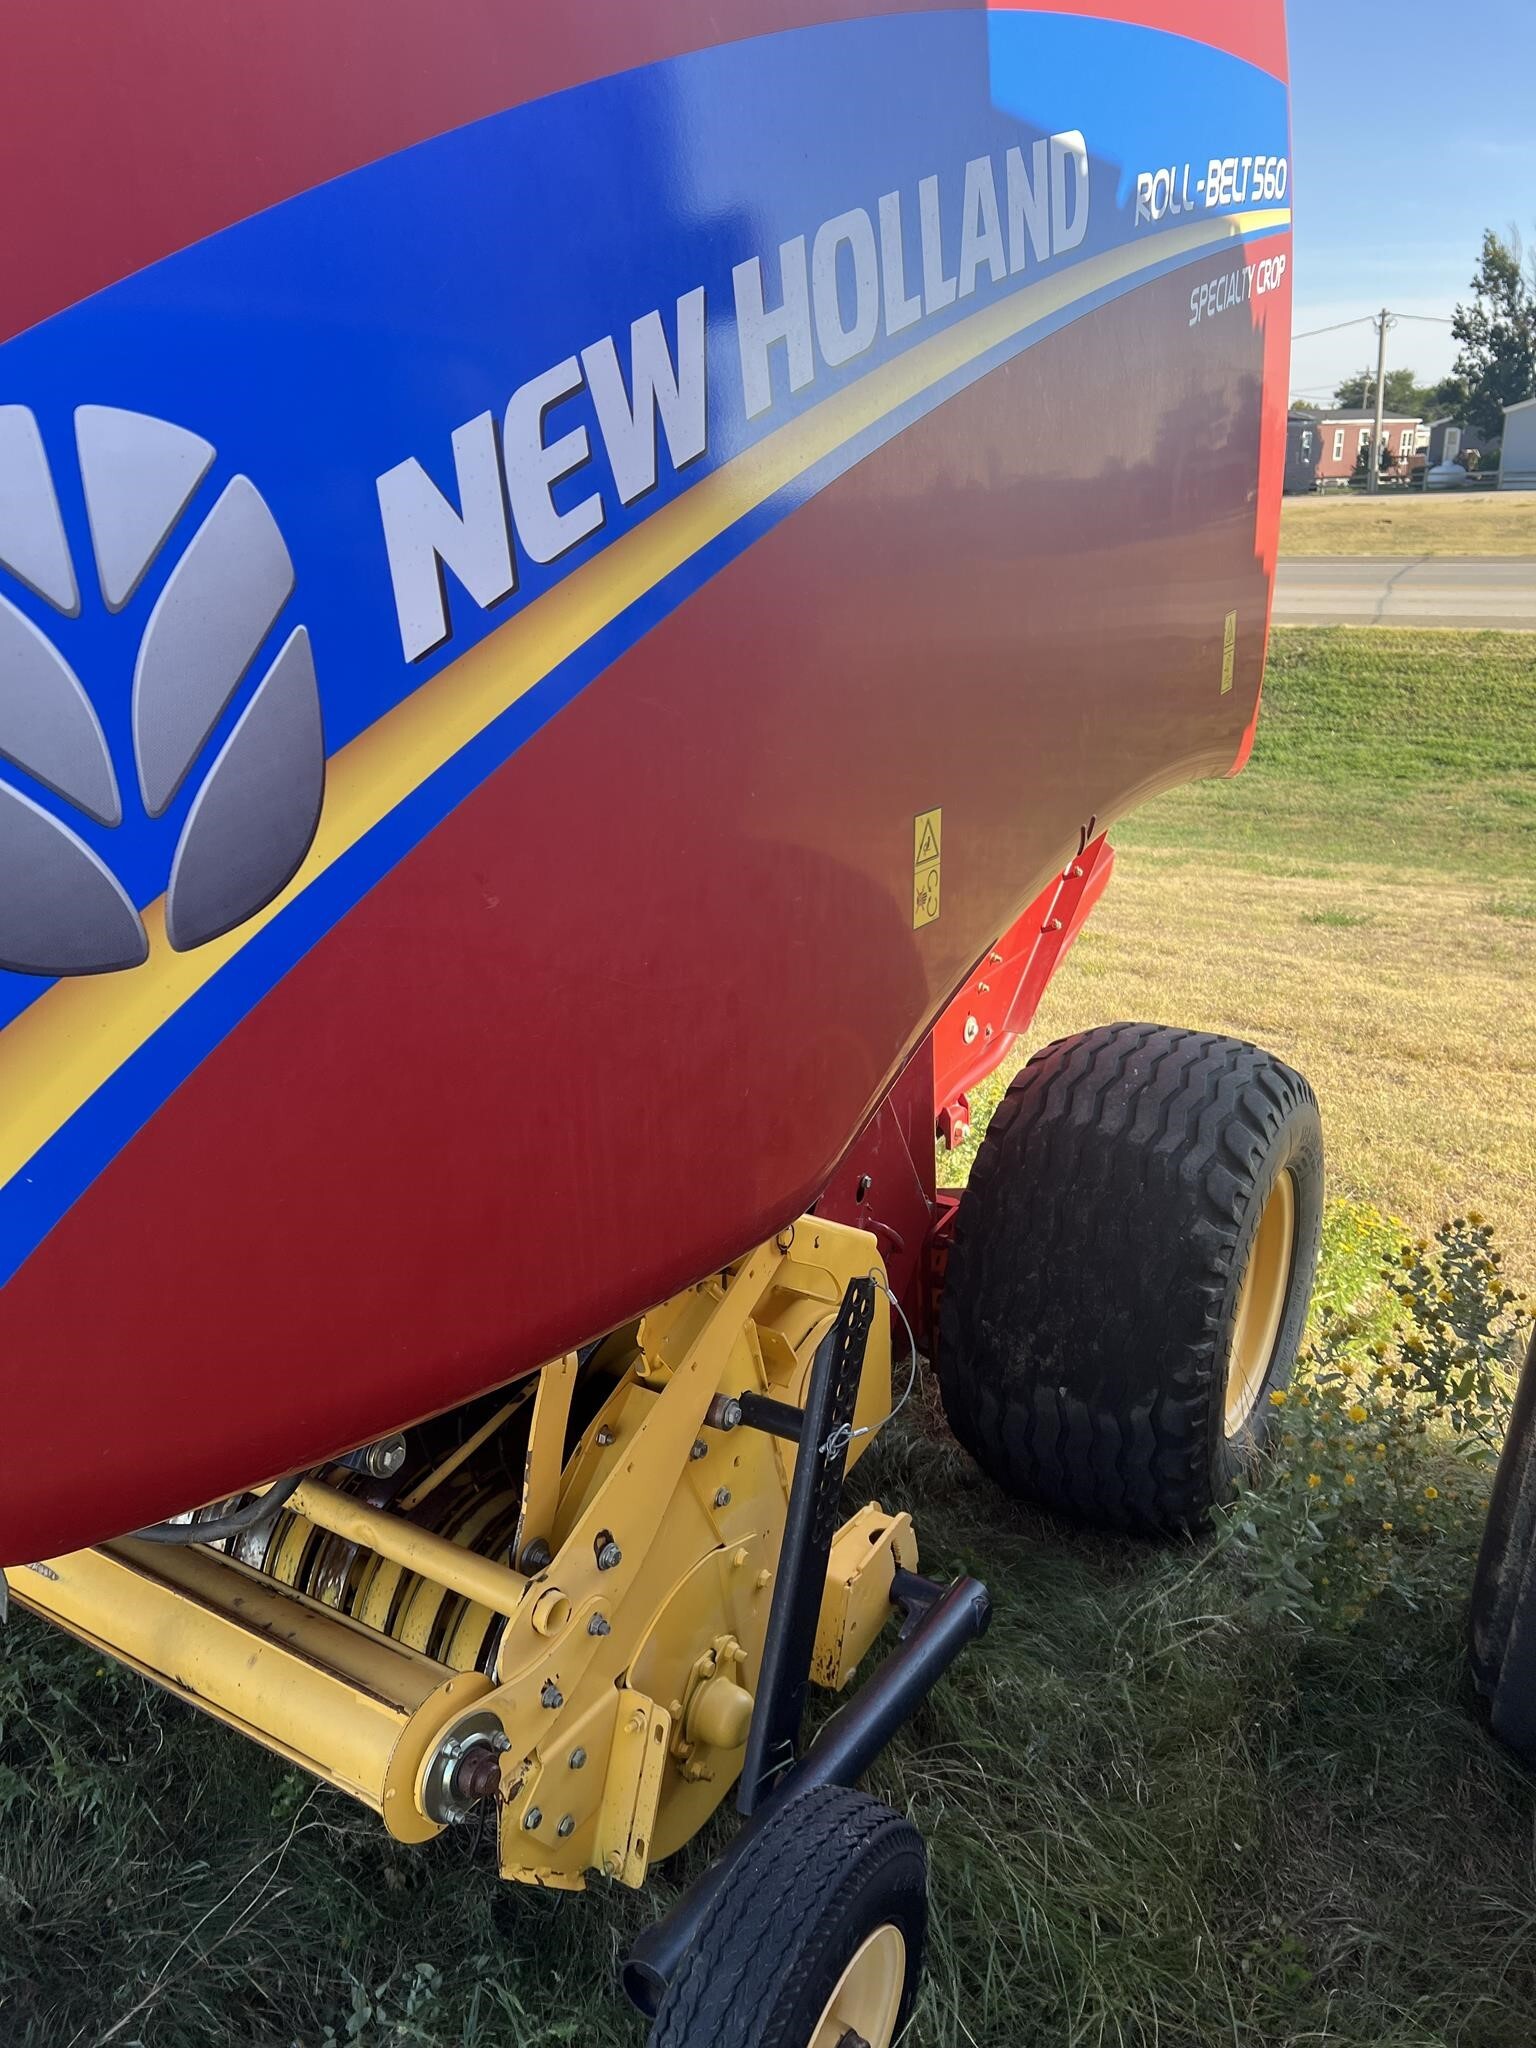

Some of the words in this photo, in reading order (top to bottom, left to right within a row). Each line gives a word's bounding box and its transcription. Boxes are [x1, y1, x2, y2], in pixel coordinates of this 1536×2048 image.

[1252, 155, 1288, 201] 560
[1188, 264, 1255, 327] SPECIALTY
[1256, 254, 1286, 294] CROP
[376, 286, 706, 664] NEW
[732, 129, 1090, 421] HOLLAND
